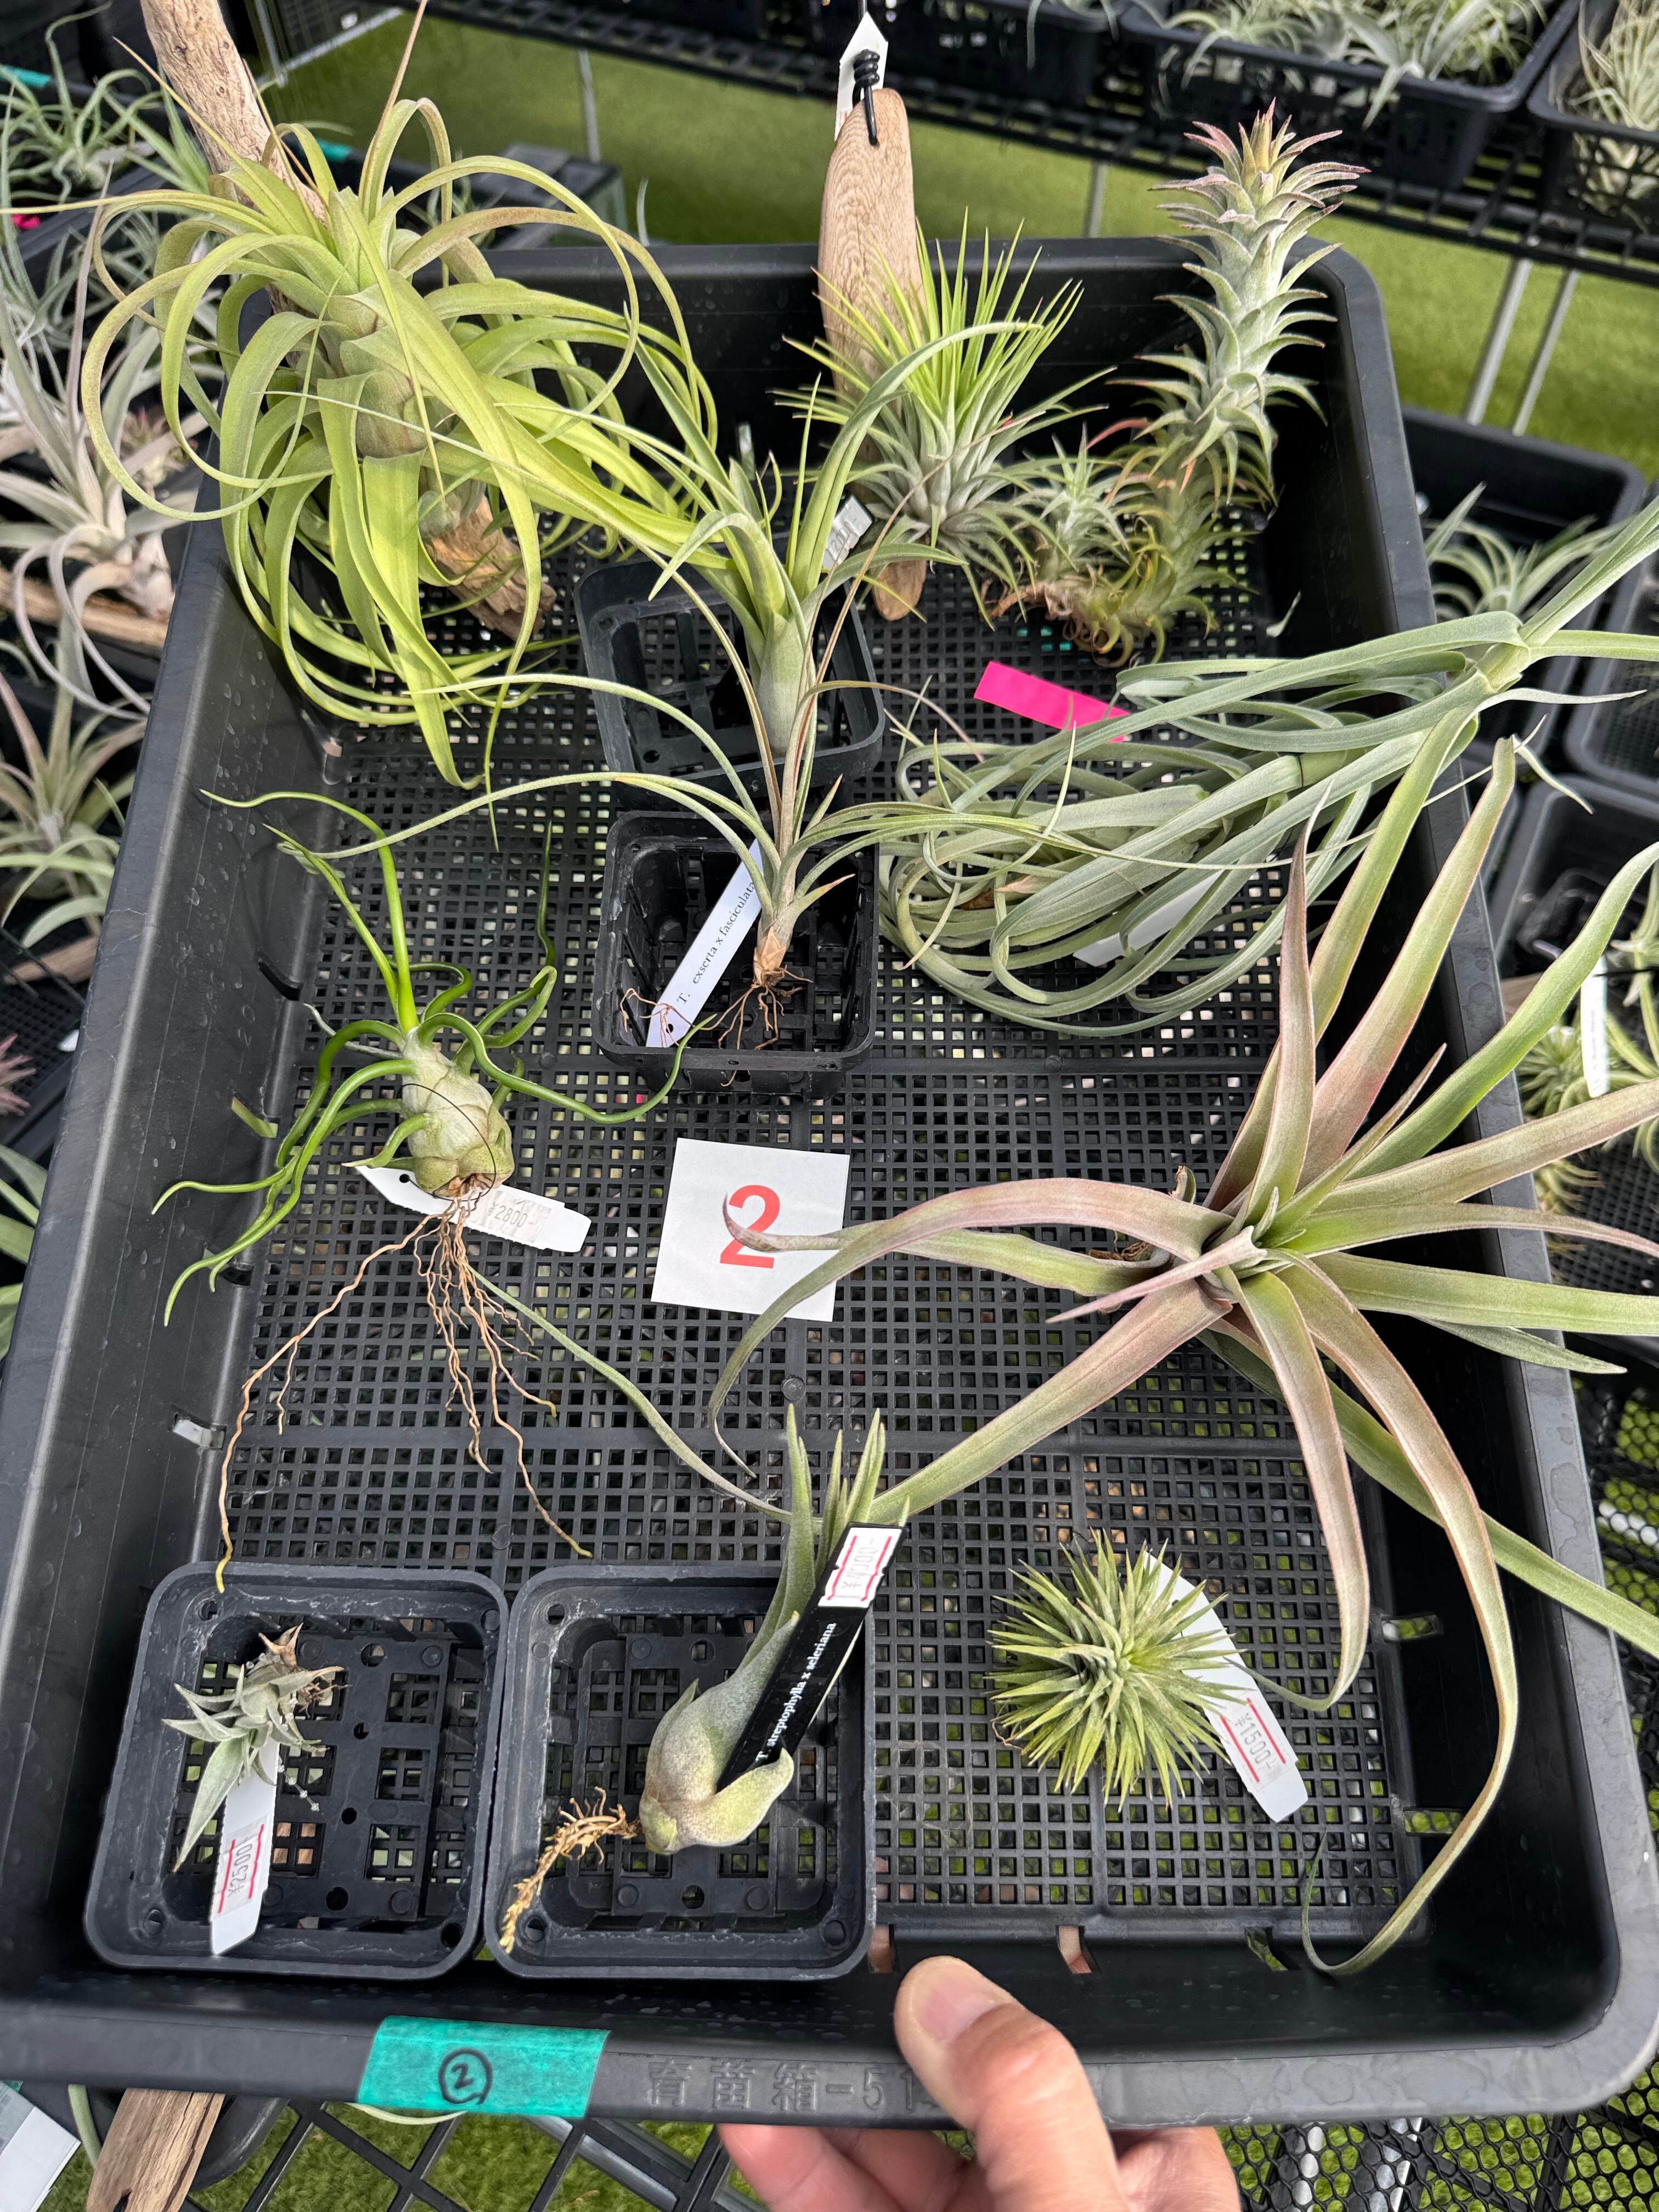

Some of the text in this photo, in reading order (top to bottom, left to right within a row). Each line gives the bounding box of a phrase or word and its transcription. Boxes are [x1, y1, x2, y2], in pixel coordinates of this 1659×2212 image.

[677, 882, 755, 1008] T. exserta x fasciculata
[720, 1185, 780, 1268] 2
[801, 1672, 812, 1680] x
[806, 1622, 837, 1671] seleriana
[767, 1681, 808, 1747] streptophylla
